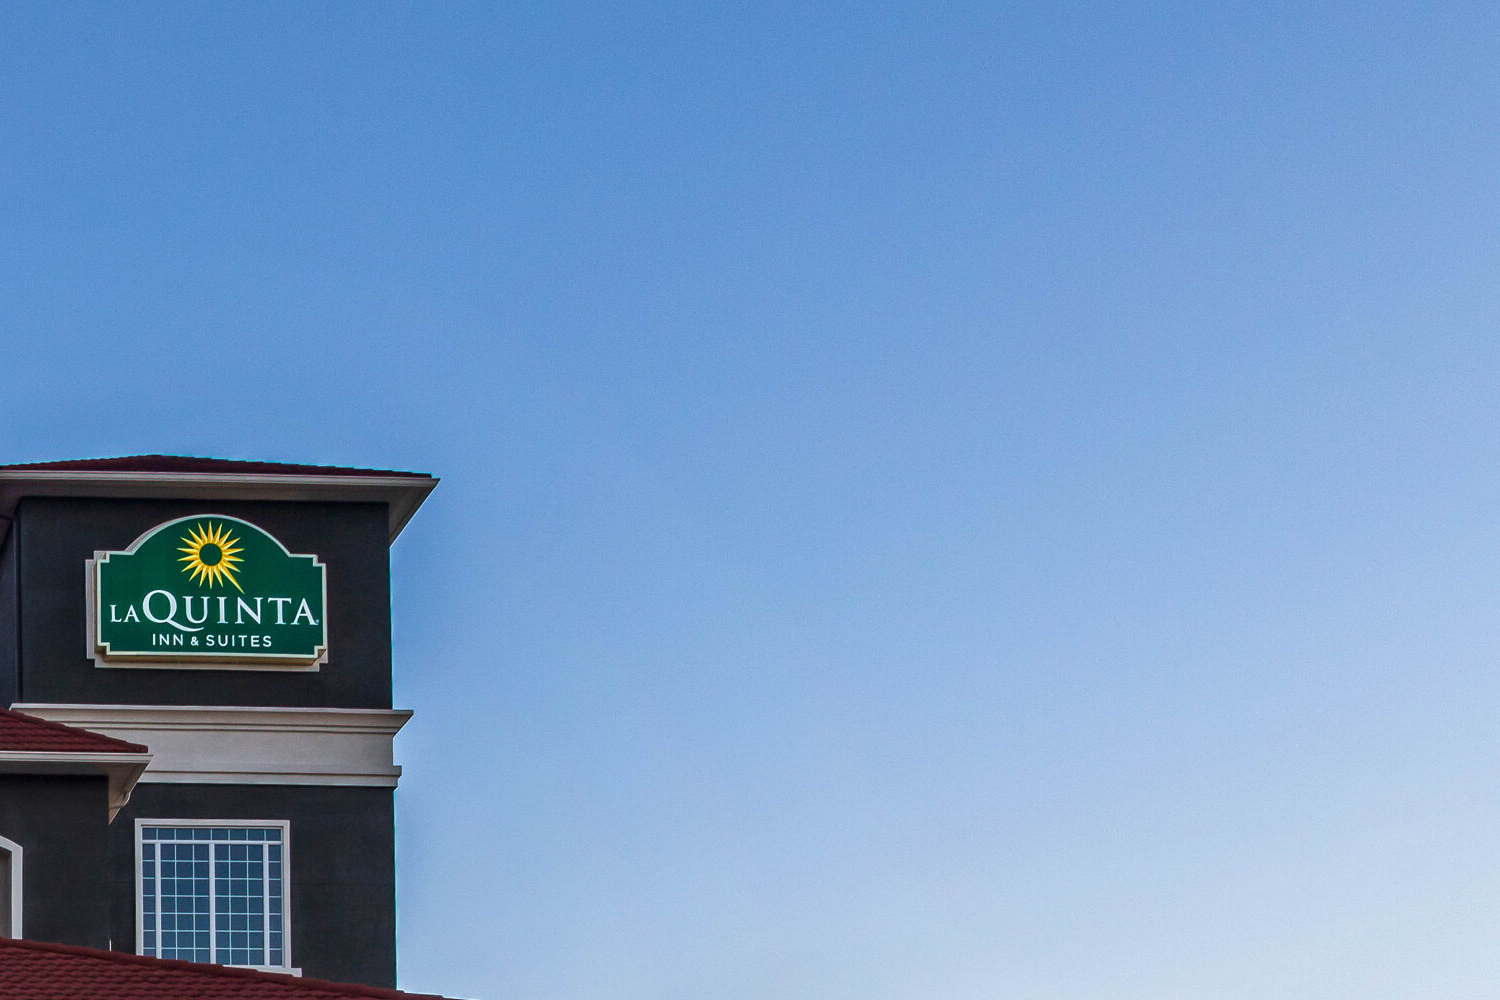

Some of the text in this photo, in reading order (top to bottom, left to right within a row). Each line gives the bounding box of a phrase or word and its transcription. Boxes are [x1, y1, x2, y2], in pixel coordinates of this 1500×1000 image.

[152, 633, 272, 648] INN & SUITES
